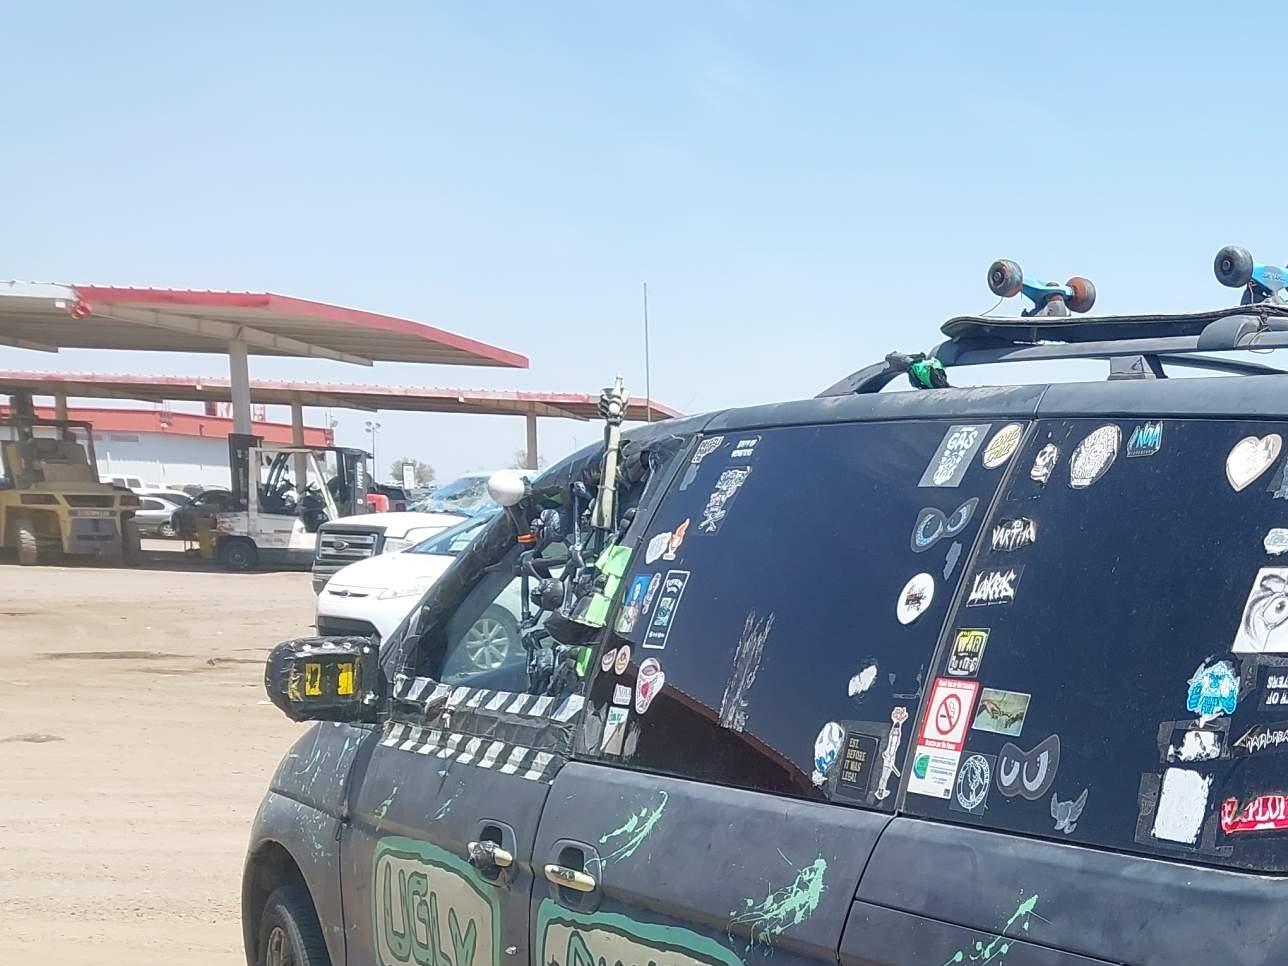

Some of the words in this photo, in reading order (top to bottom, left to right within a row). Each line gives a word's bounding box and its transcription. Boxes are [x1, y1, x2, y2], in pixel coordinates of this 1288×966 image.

[947, 429, 978, 450] GAS
[1266, 691, 1280, 705] OF
[846, 749, 867, 762] BEFORE
[850, 761, 862, 773] WAS
[842, 769, 857, 783] LEGAL
